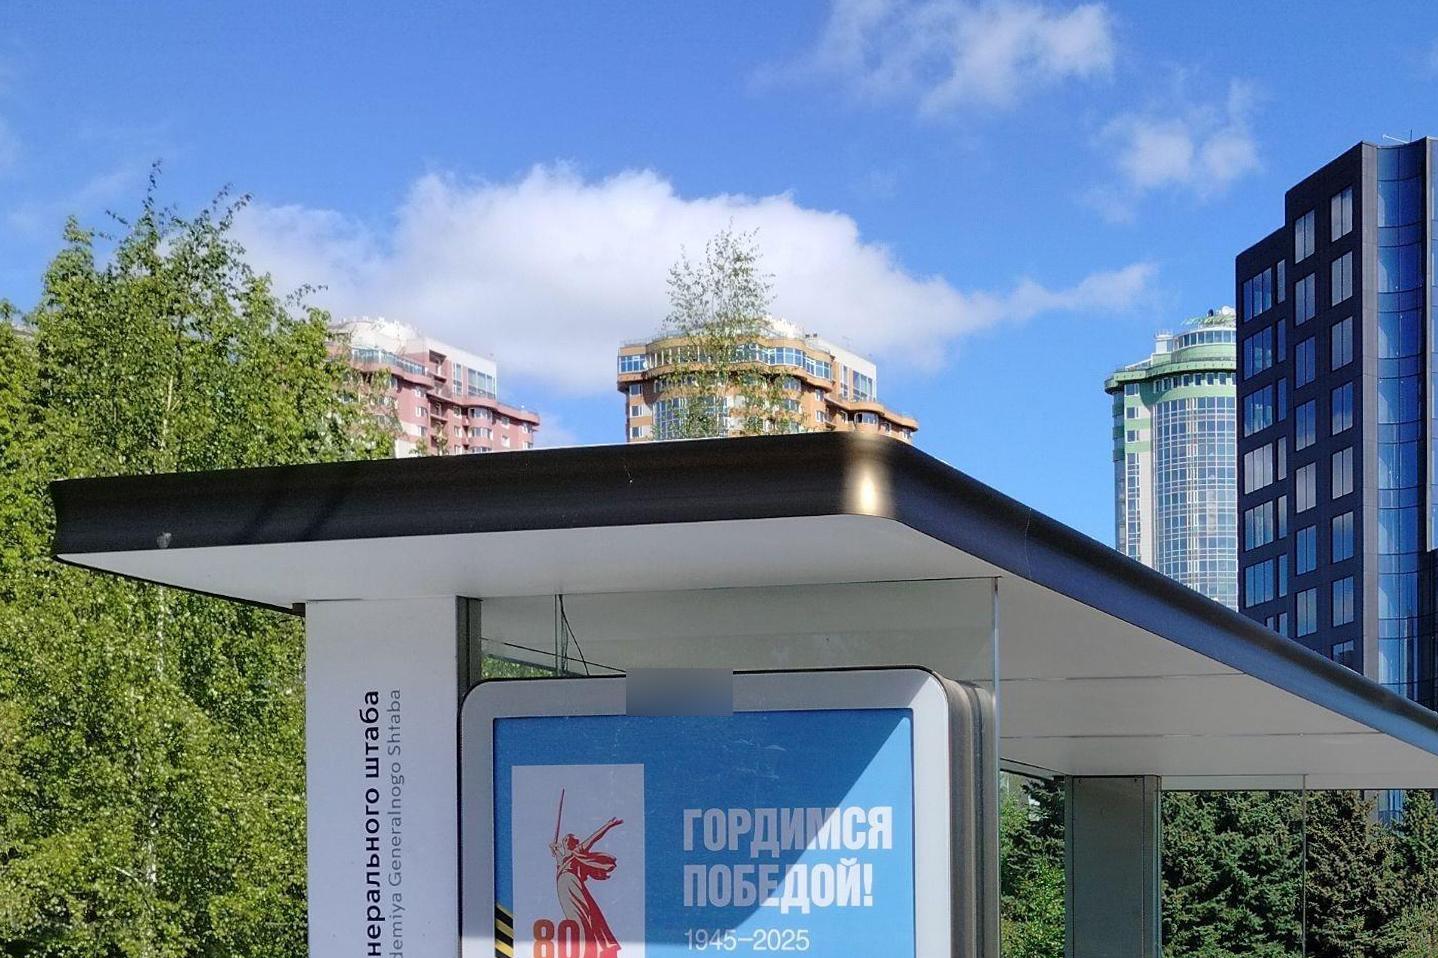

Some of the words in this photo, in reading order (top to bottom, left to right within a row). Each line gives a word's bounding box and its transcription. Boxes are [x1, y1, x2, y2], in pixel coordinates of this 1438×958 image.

[359, 690, 380, 778] штаба
[387, 689, 401, 756] Shtaba
[387, 762, 405, 887] Generalnogo
[683, 806, 893, 858] ГОРДИМСЯ
[683, 857, 873, 914] ПОБЕДОЙ!
